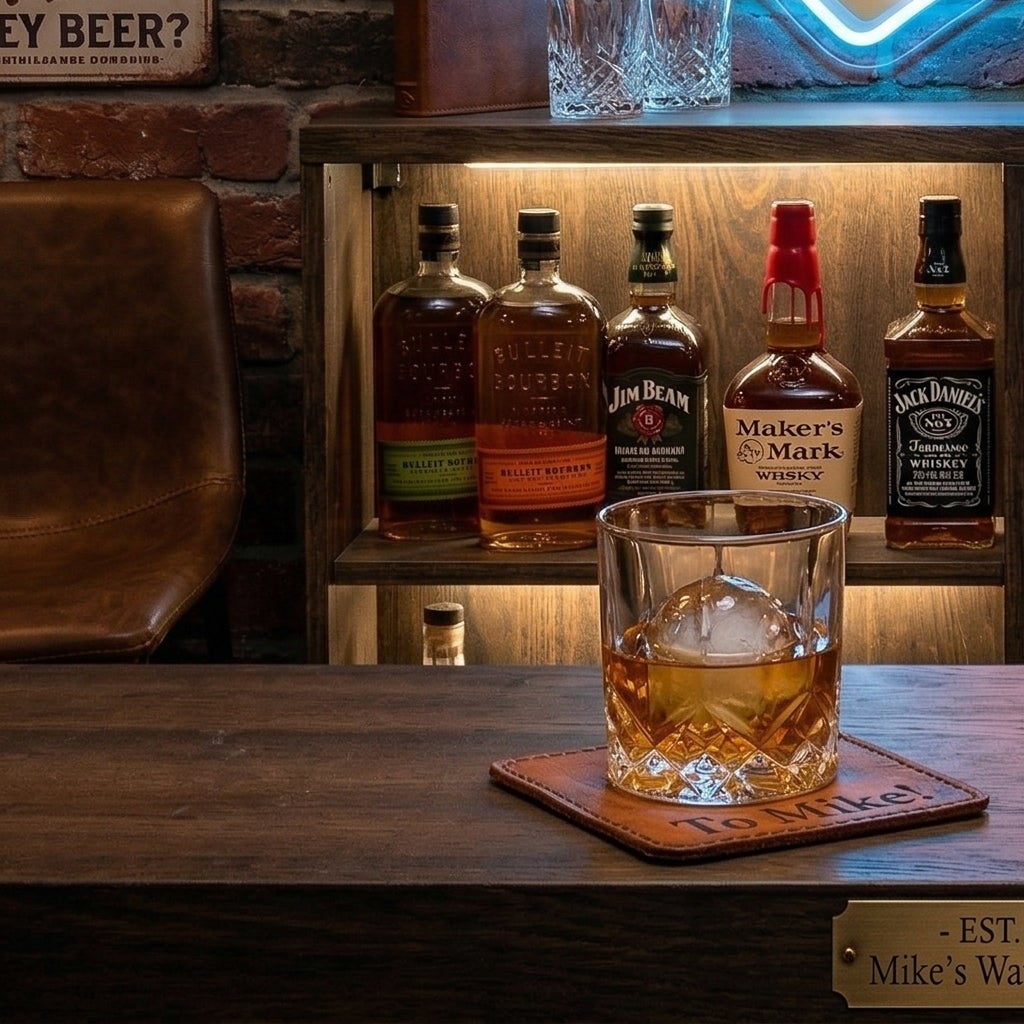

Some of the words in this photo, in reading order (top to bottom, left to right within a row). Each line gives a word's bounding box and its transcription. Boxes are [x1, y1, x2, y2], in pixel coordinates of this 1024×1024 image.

[0, 13, 46, 48] EY
[59, 12, 190, 48] BEER?
[608, 385, 640, 414] JIM
[642, 379, 690, 415] BEAM
[893, 386, 930, 414] JACK
[735, 418, 844, 437] Maker's
[767, 442, 845, 460] Mark
[909, 459, 969, 469] WHISKEY
[669, 817, 757, 835] To
[760, 784, 934, 824] Mike!
[958, 917, 1021, 944] EST.
